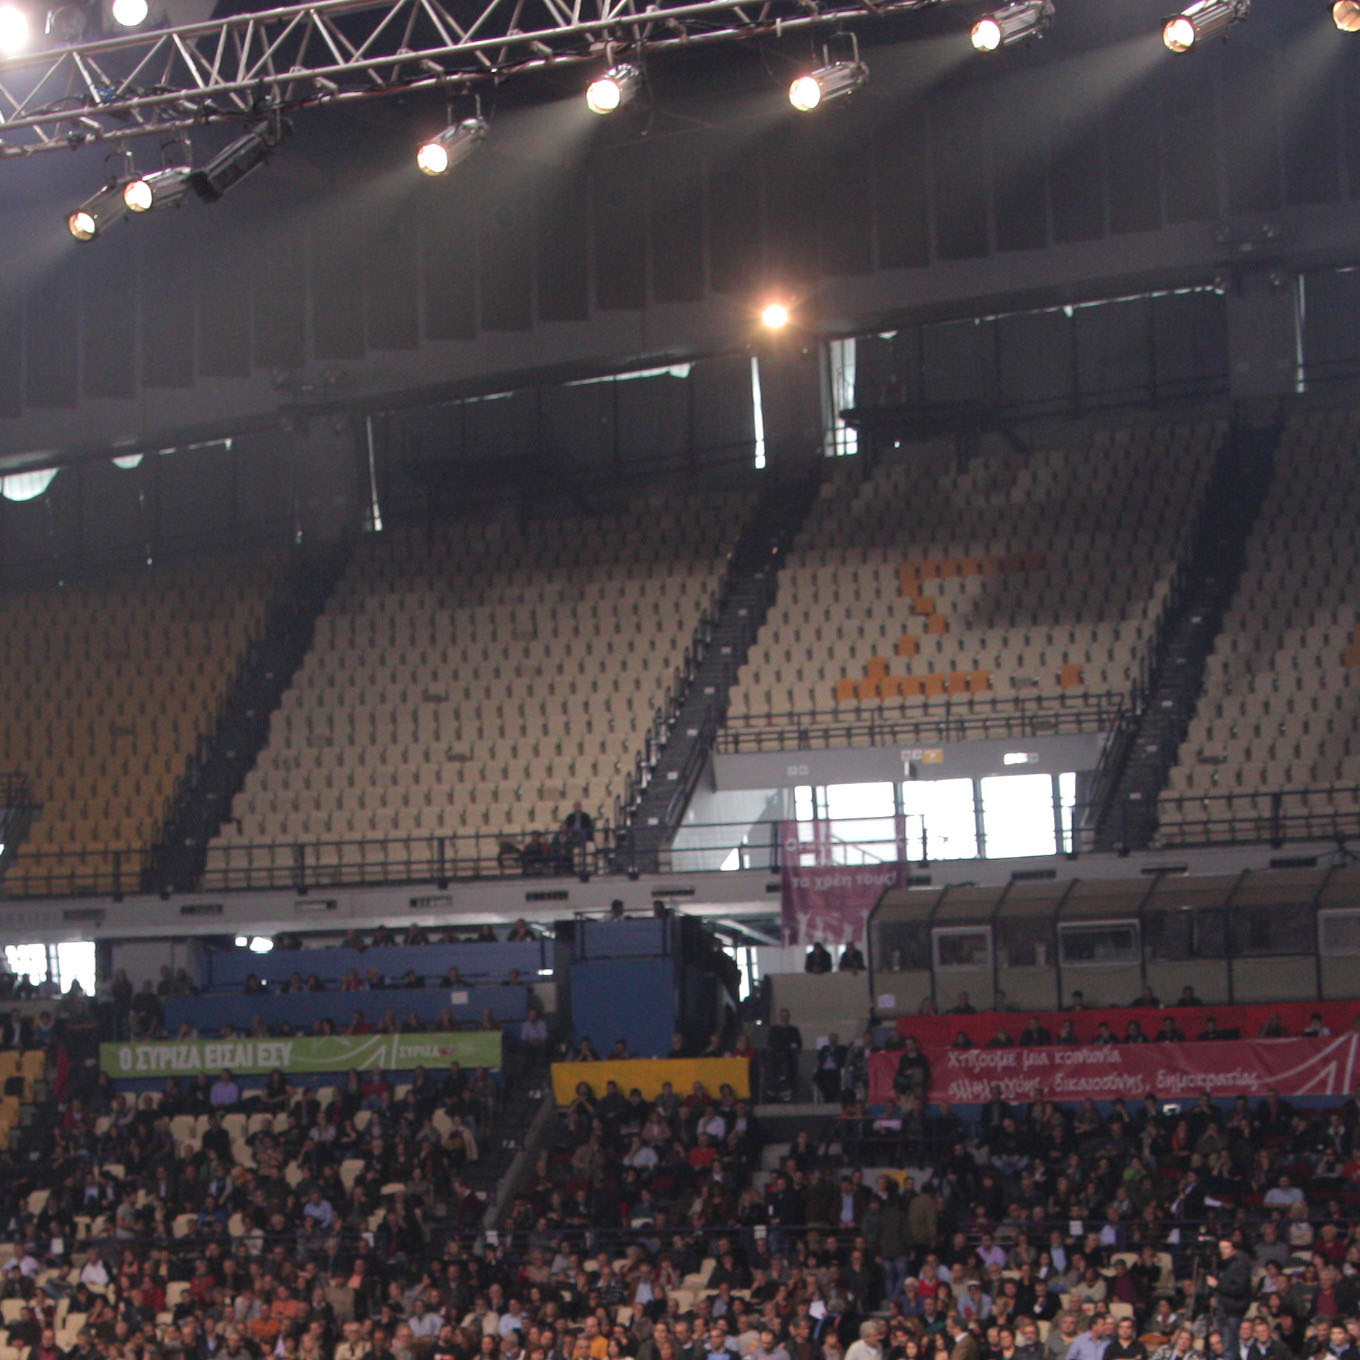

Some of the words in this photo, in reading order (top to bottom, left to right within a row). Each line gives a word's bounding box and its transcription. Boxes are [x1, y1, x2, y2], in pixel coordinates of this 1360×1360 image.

[119, 1046, 133, 1071] Ο
[135, 1044, 202, 1072] ΣΥΡΙΖΑ
[204, 1042, 253, 1069] ΕΙΣΑΙ
[257, 1041, 294, 1068] ΕΣΥ
[1022, 1048, 1051, 1072] μια
